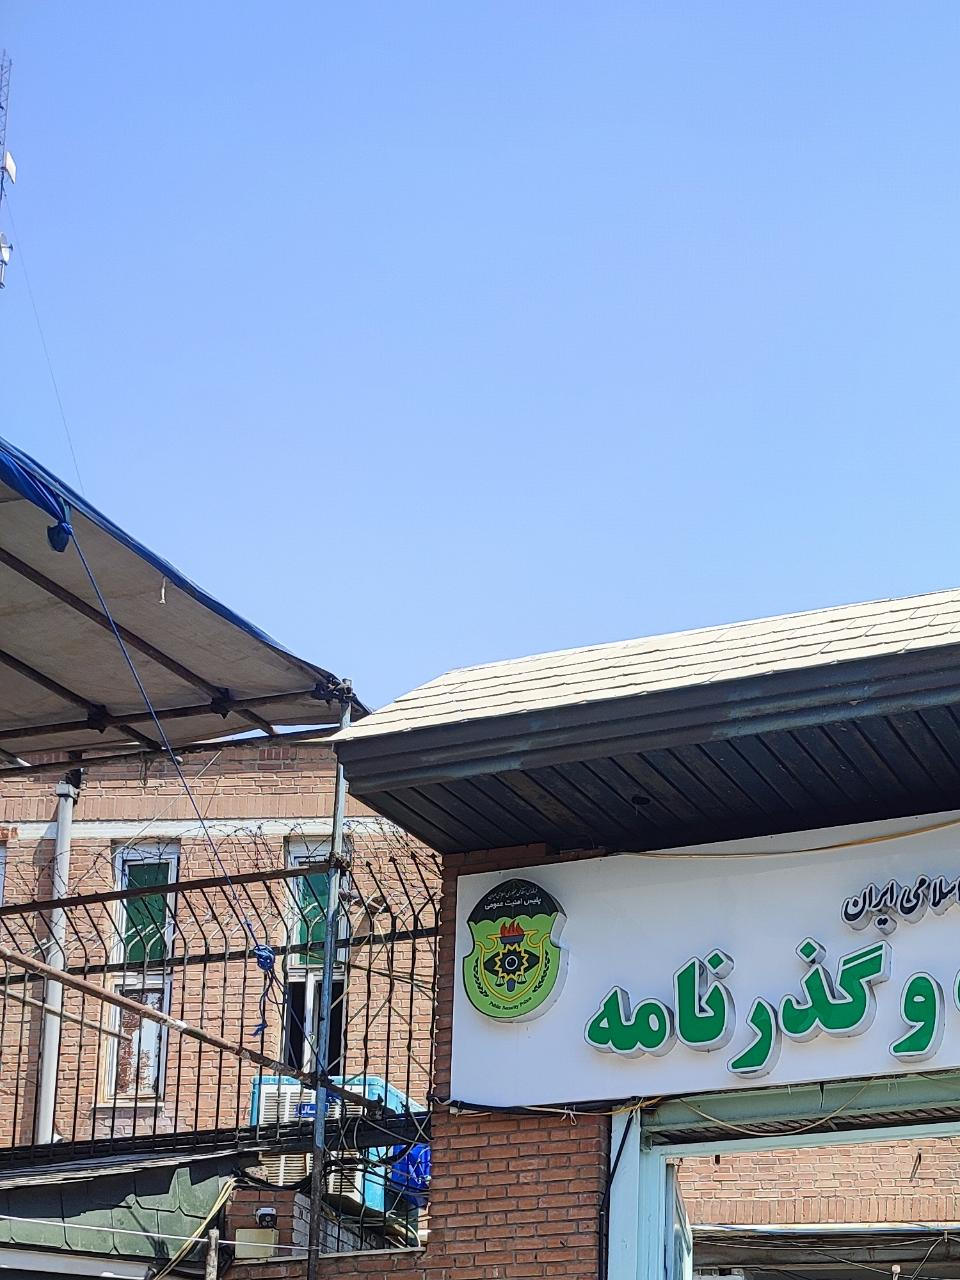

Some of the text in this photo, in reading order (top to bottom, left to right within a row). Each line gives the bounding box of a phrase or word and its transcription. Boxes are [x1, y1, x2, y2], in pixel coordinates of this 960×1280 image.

[843, 882, 896, 928] ایران
[587, 942, 883, 1070] گذرنامه
[892, 976, 937, 1053] و
